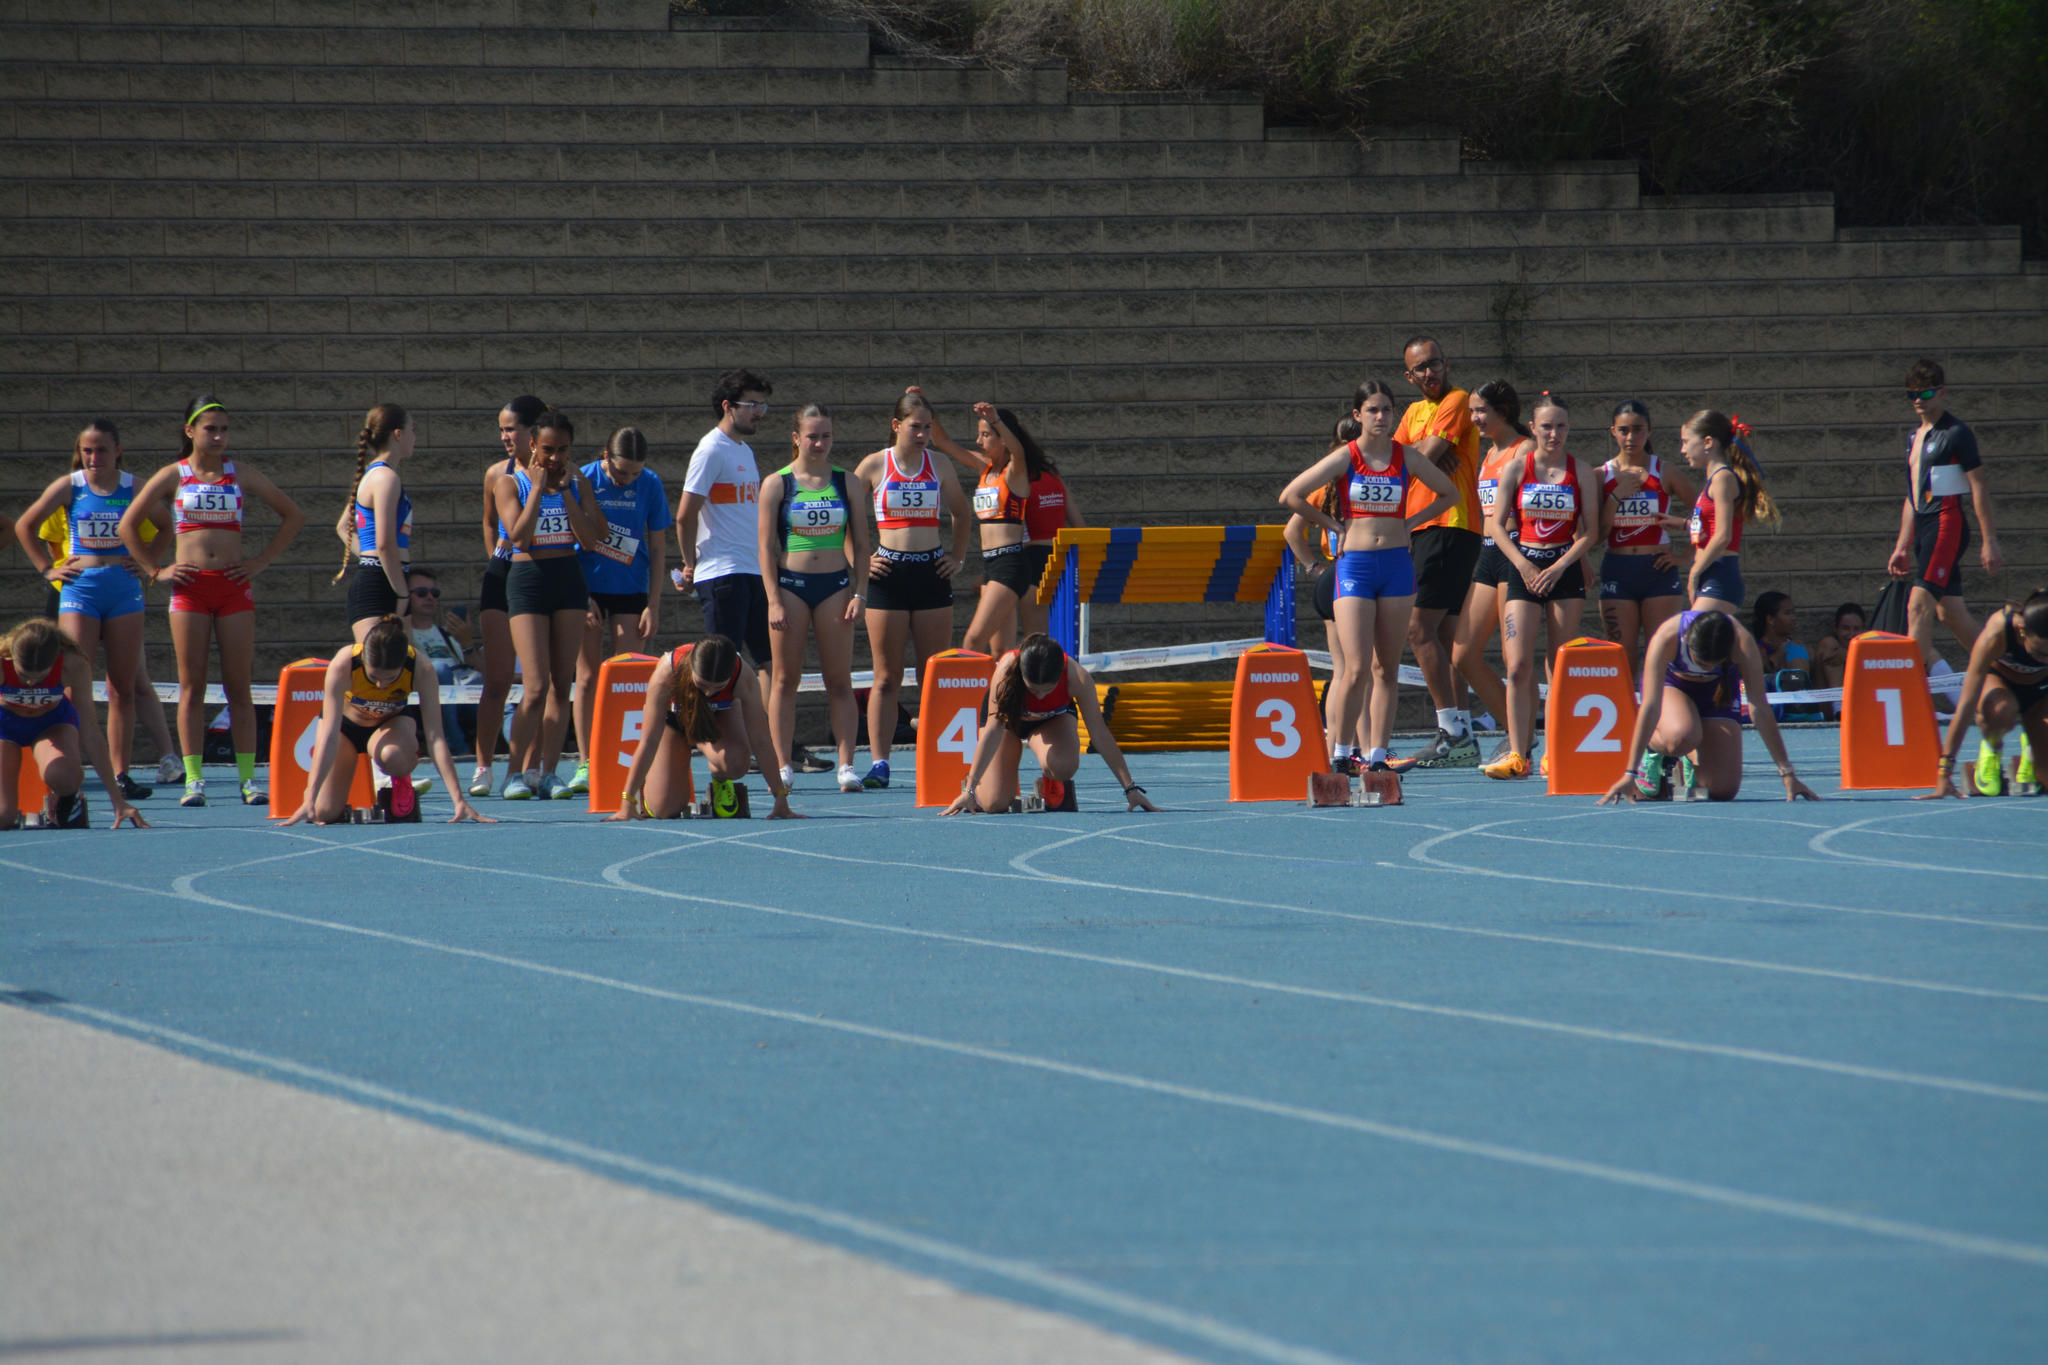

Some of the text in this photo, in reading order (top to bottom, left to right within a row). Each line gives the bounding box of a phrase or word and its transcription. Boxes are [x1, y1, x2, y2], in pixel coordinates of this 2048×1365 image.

[901, 491, 923, 507] 53
[1360, 485, 1393, 501] 332
[1530, 493, 1566, 509] 456
[194, 494, 228, 510] 151
[1355, 503, 1398, 512] mutuacat
[1616, 501, 1649, 516] 448
[187, 512, 233, 520] mutuacat
[807, 510, 830, 526] 99
[890, 509, 935, 518] mutuacat
[1525, 510, 1571, 519] mutuacat
[540, 517, 571, 533] 431
[878, 546, 902, 561] NIKE
[902, 552, 929, 562] PRO
[1527, 550, 1556, 559] PRO
[1863, 658, 1914, 669] MONDO
[1250, 673, 1299, 683] MONDO
[1569, 667, 1618, 677] MONDO
[938, 678, 988, 688] MONDO
[1573, 694, 1622, 752] 2
[1875, 689, 1905, 746] 1
[937, 707, 978, 764] 4
[1255, 698, 1301, 759] 3
